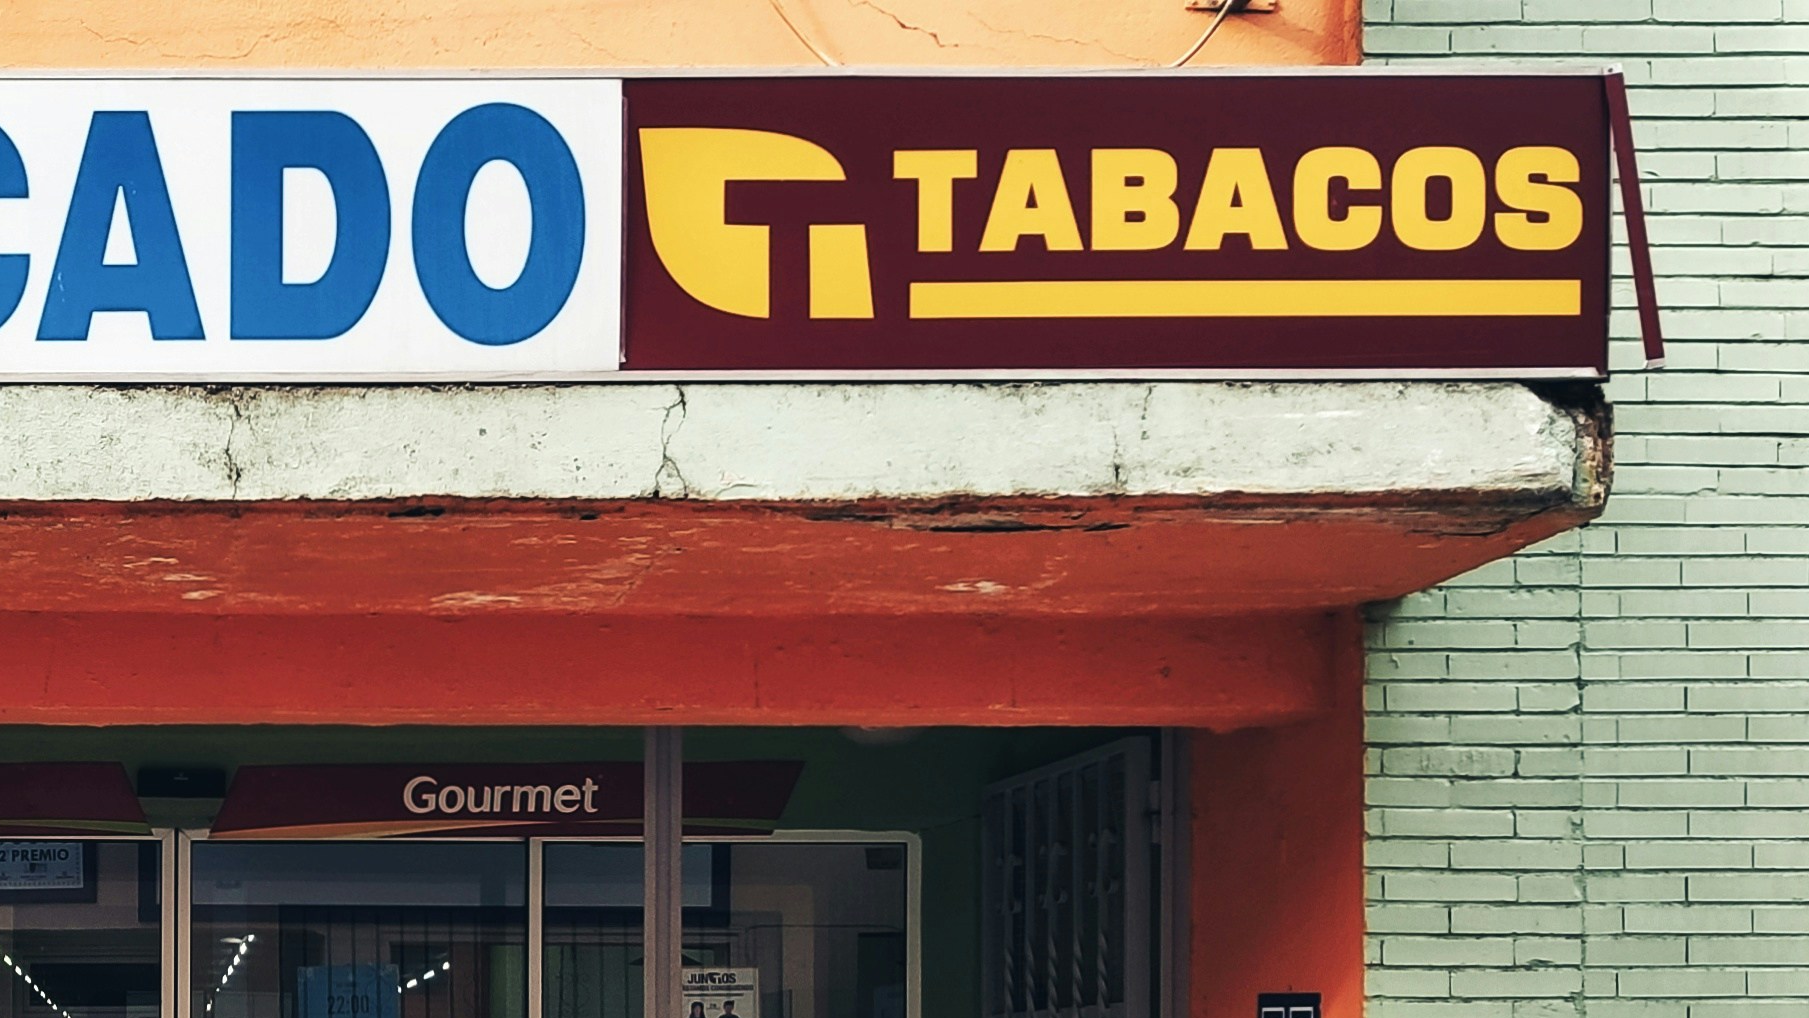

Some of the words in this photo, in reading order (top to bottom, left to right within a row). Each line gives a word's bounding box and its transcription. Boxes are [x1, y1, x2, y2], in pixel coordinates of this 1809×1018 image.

[894, 147, 1582, 251] TABACOS
[403, 776, 599, 814] Gourmet
[11, 849, 69, 862] PREMIO
[327, 994, 370, 1015] 22:00
